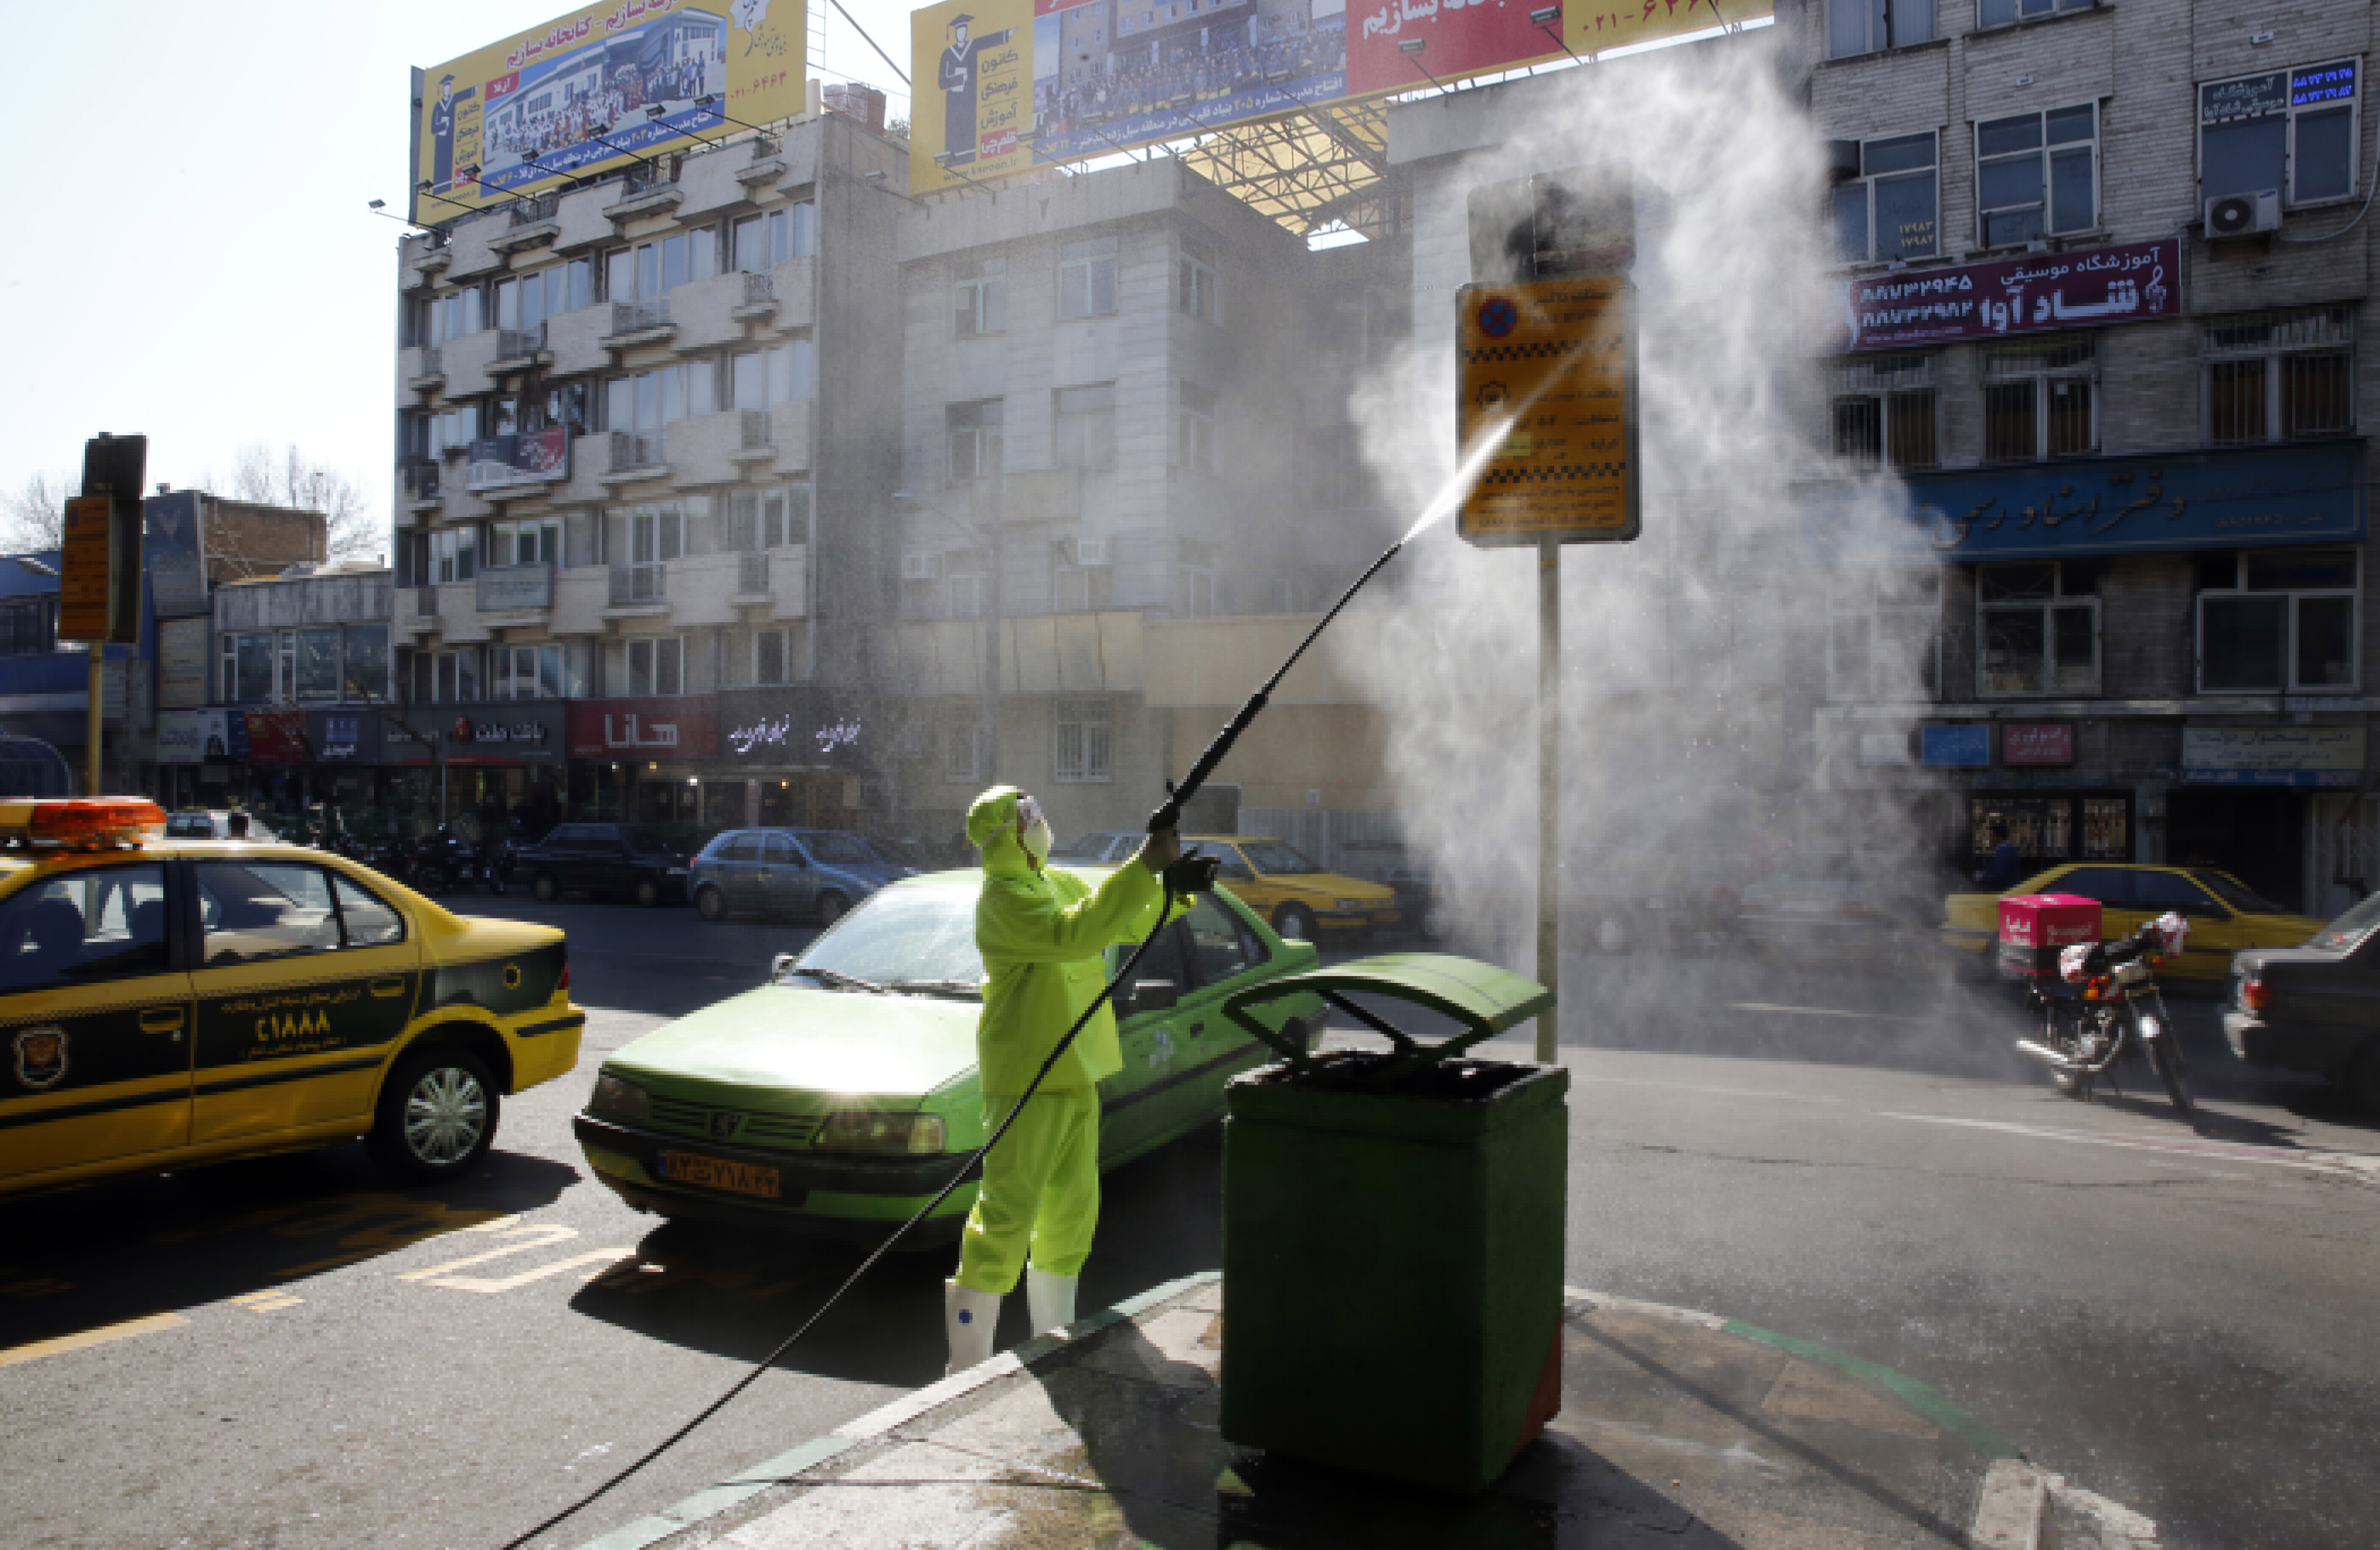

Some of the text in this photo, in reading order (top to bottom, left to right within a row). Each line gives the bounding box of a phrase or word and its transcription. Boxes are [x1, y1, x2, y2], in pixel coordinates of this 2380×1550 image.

[545, 14, 594, 48] کتابخانه
[505, 37, 544, 71] بسازیم
[982, 50, 1018, 73] کانون
[981, 77, 1018, 101] فرهنگی
[981, 102, 1017, 130] آموزش
[2000, 247, 2161, 286] آموزشگاه موسیقی
